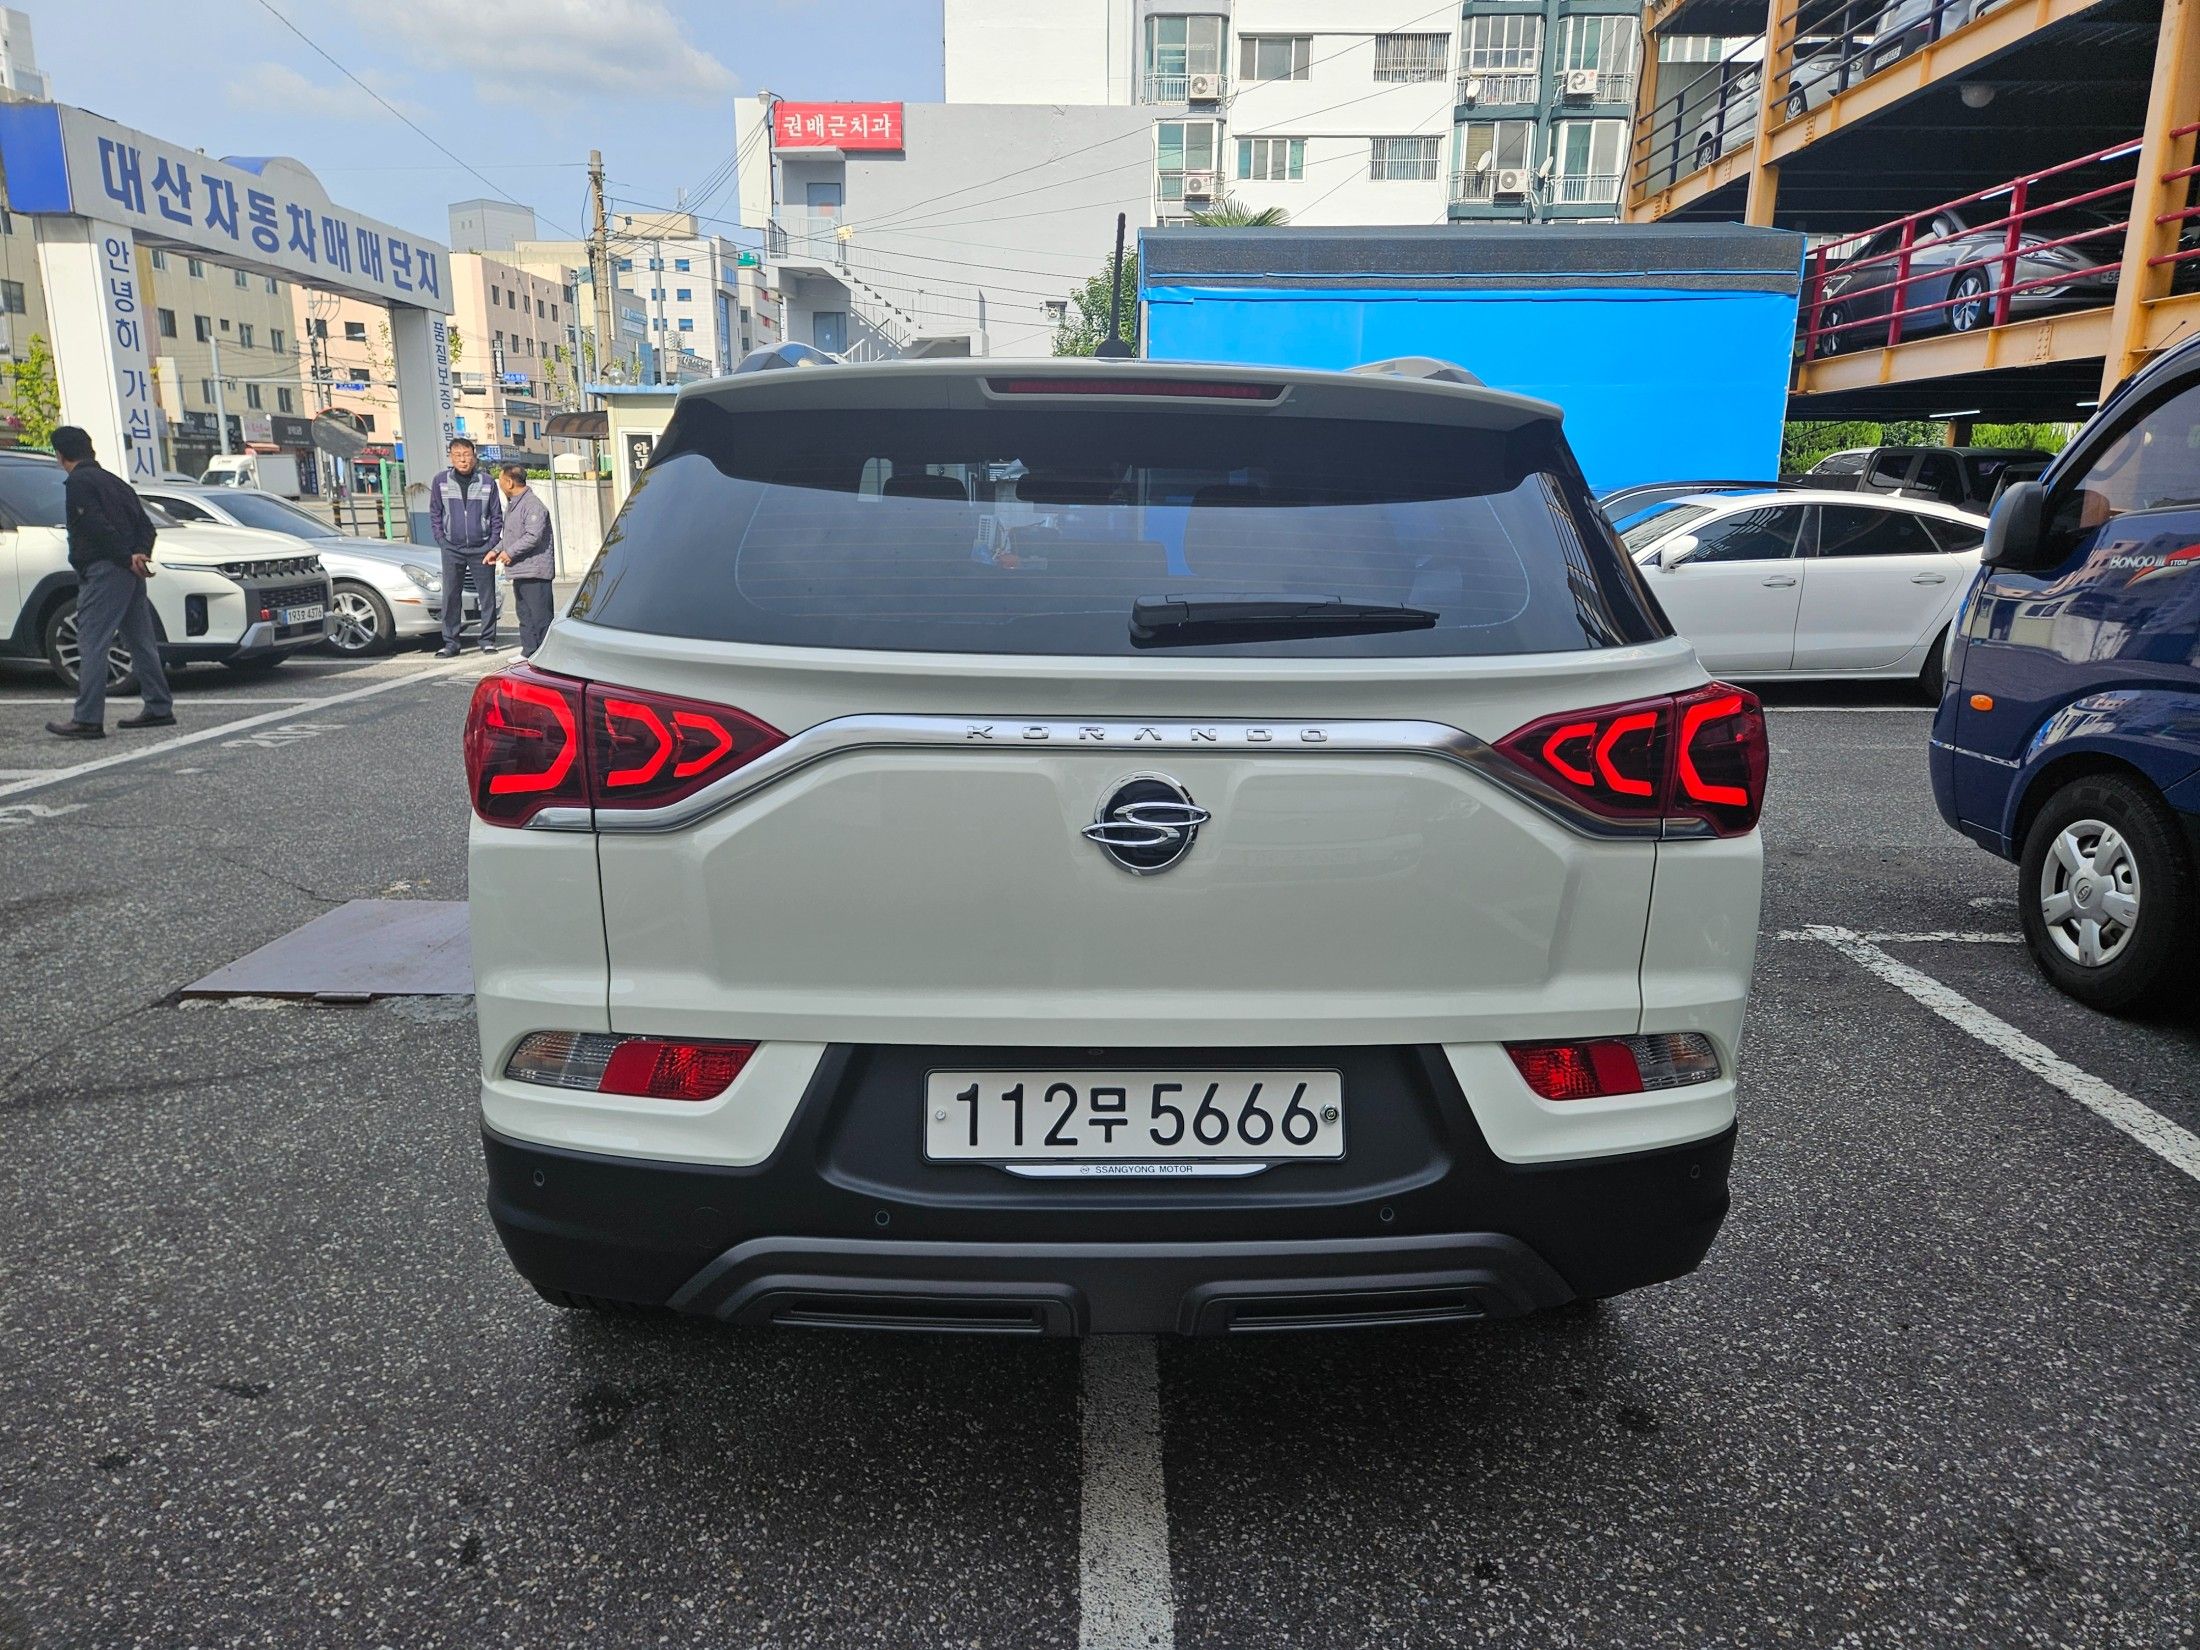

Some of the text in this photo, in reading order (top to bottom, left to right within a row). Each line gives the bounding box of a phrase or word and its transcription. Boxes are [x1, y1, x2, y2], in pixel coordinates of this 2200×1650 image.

[783, 113, 892, 138] 권배근치과
[97, 136, 440, 299] 대산자동차매매단지
[105, 238, 140, 351] 안녕히
[966, 725, 1328, 742] KORANDO
[1095, 1165, 1193, 1174] SSANGYONG MOTOR
